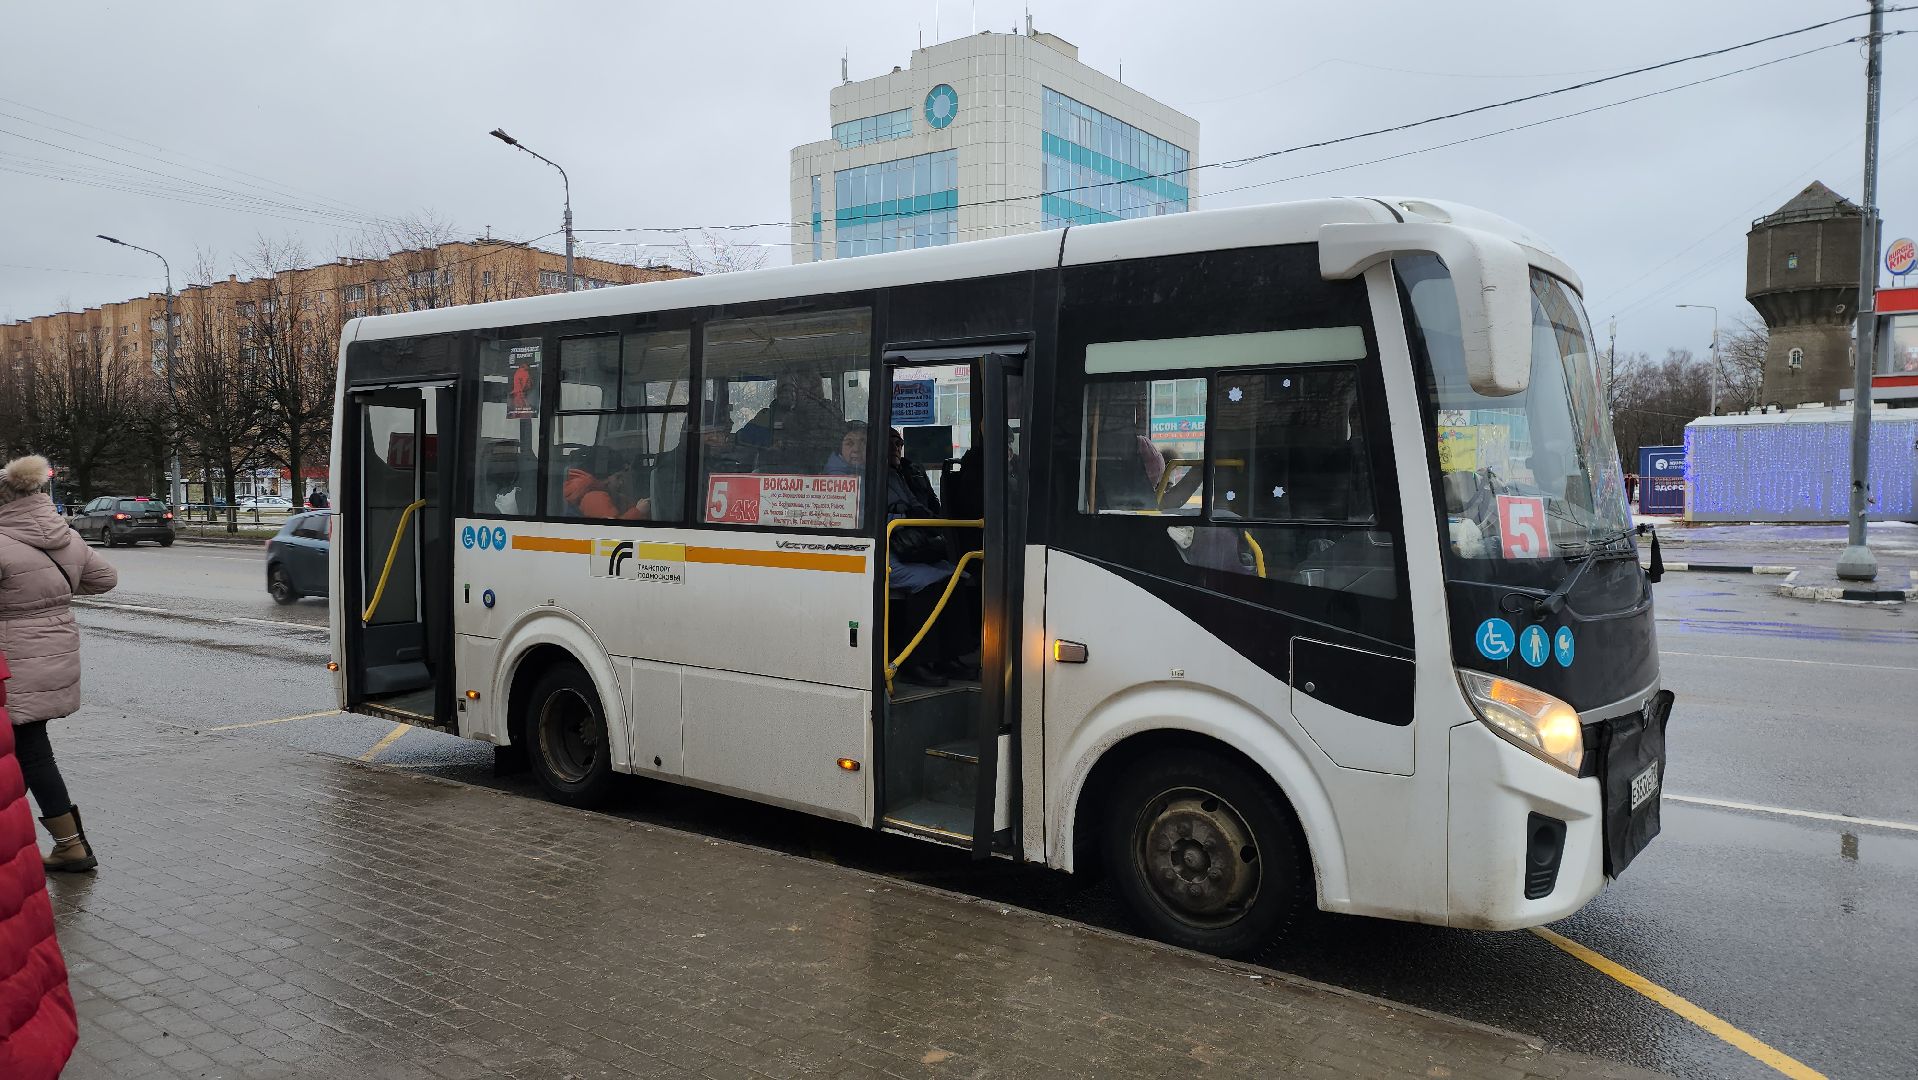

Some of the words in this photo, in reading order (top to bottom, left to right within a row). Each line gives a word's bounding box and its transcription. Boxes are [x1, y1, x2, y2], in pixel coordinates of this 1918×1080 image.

[1888, 242, 1913, 262] BURGER
[1889, 248, 1915, 269] KING
[763, 477, 804, 491] ВОКЗАЛ
[812, 479, 856, 493] ЛЕСНАЯ
[710, 481, 729, 519] 5
[1509, 503, 1540, 559] 5
[637, 563, 671, 573] ТРАНСПОРТ
[637, 571, 681, 582] ПОДМОСКОВЬЯ
